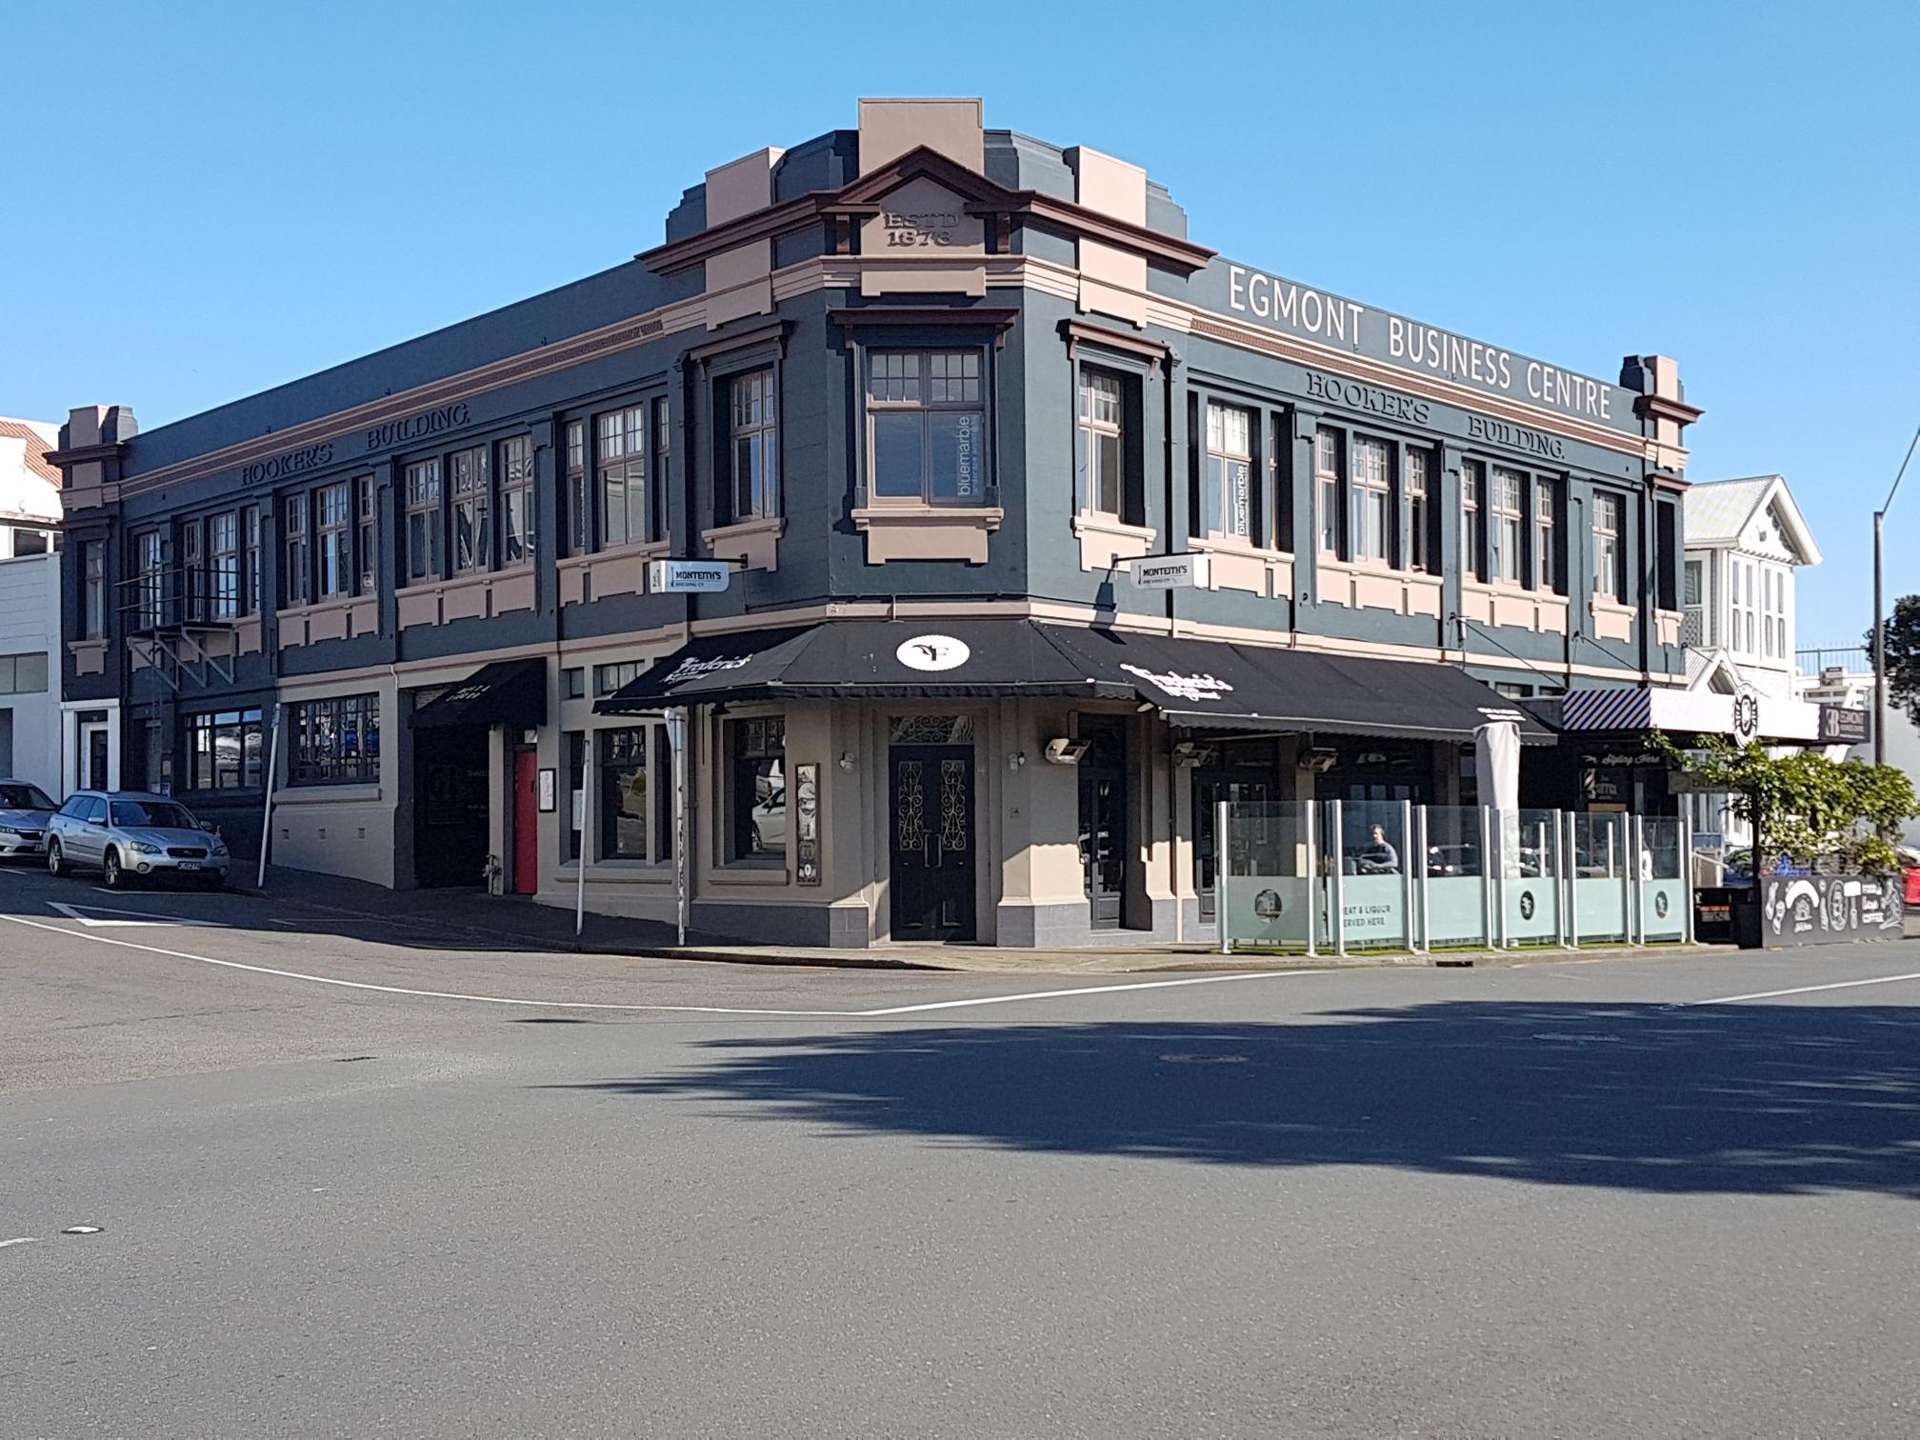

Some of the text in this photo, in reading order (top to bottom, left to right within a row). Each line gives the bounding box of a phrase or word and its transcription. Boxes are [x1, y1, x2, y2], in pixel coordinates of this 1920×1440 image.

[1229, 265, 1611, 420] EGMONT BUSINESS CENTRE
[1306, 372, 1431, 424] HOOKER'S
[241, 443, 334, 486] HOOKER'S
[957, 416, 971, 496] bluemarble
[675, 570, 722, 580] MONTEITH'S
[1143, 564, 1188, 577] MONTEITH'S
[1343, 917, 1366, 928] ERVED
